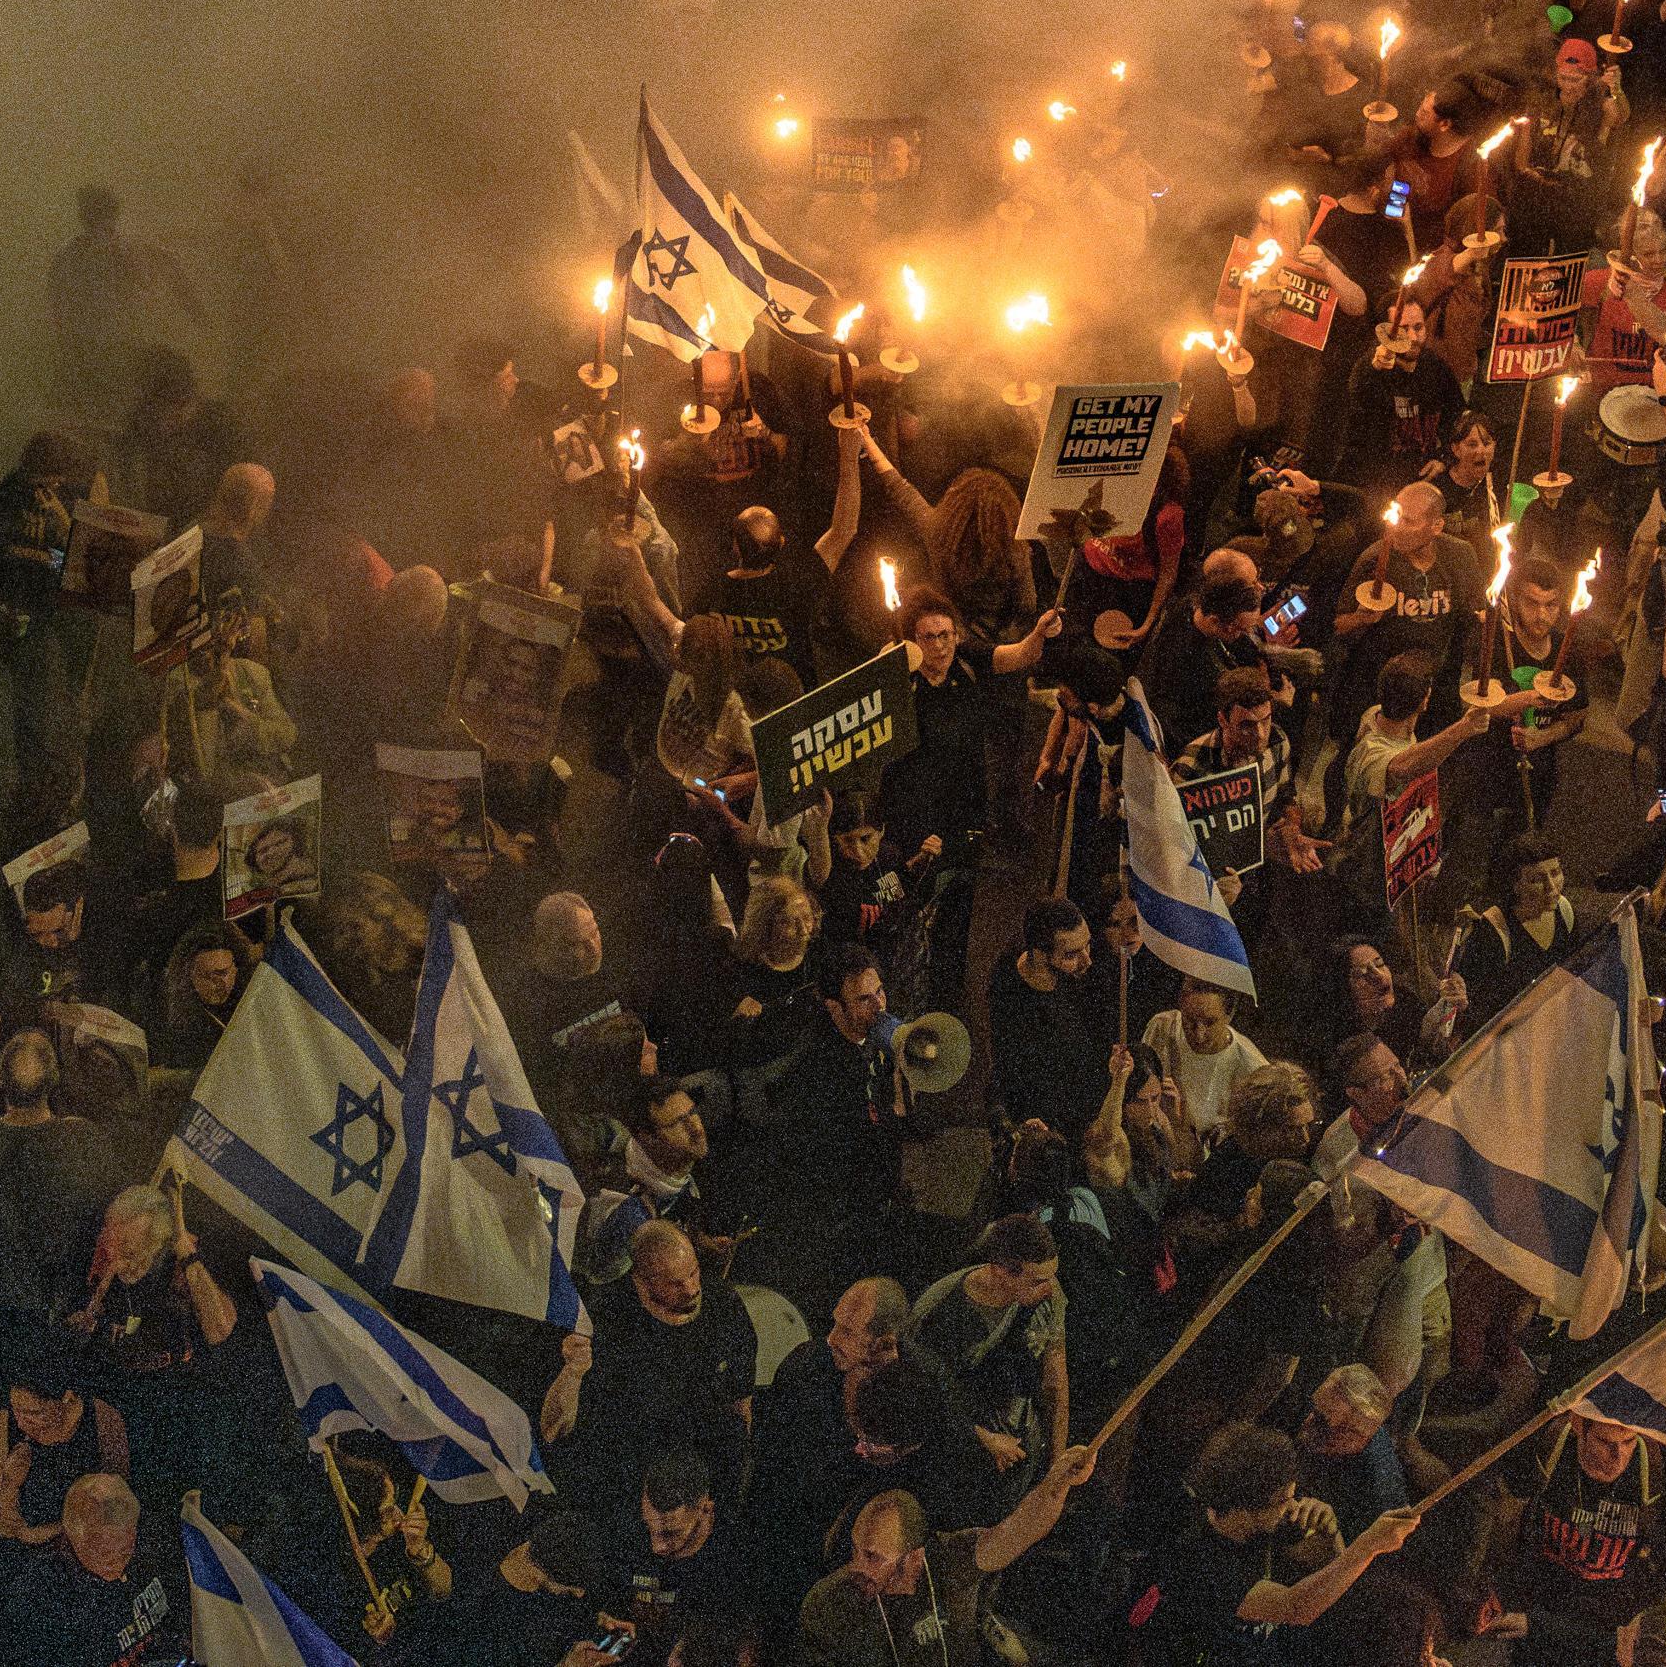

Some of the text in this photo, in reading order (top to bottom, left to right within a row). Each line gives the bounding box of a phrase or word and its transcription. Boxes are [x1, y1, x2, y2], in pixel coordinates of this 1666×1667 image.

[1498, 315, 1575, 343] בחיות
[1496, 341, 1572, 376] עכשיו!
[1075, 396, 1158, 415] GET MY
[1070, 416, 1153, 435] PEOPLE
[1062, 436, 1148, 460] HOME!
[790, 688, 884, 761] עסקה
[788, 714, 894, 795] עכשיו!
[1183, 775, 1253, 812] כשהוא
[1226, 803, 1256, 833] הם
